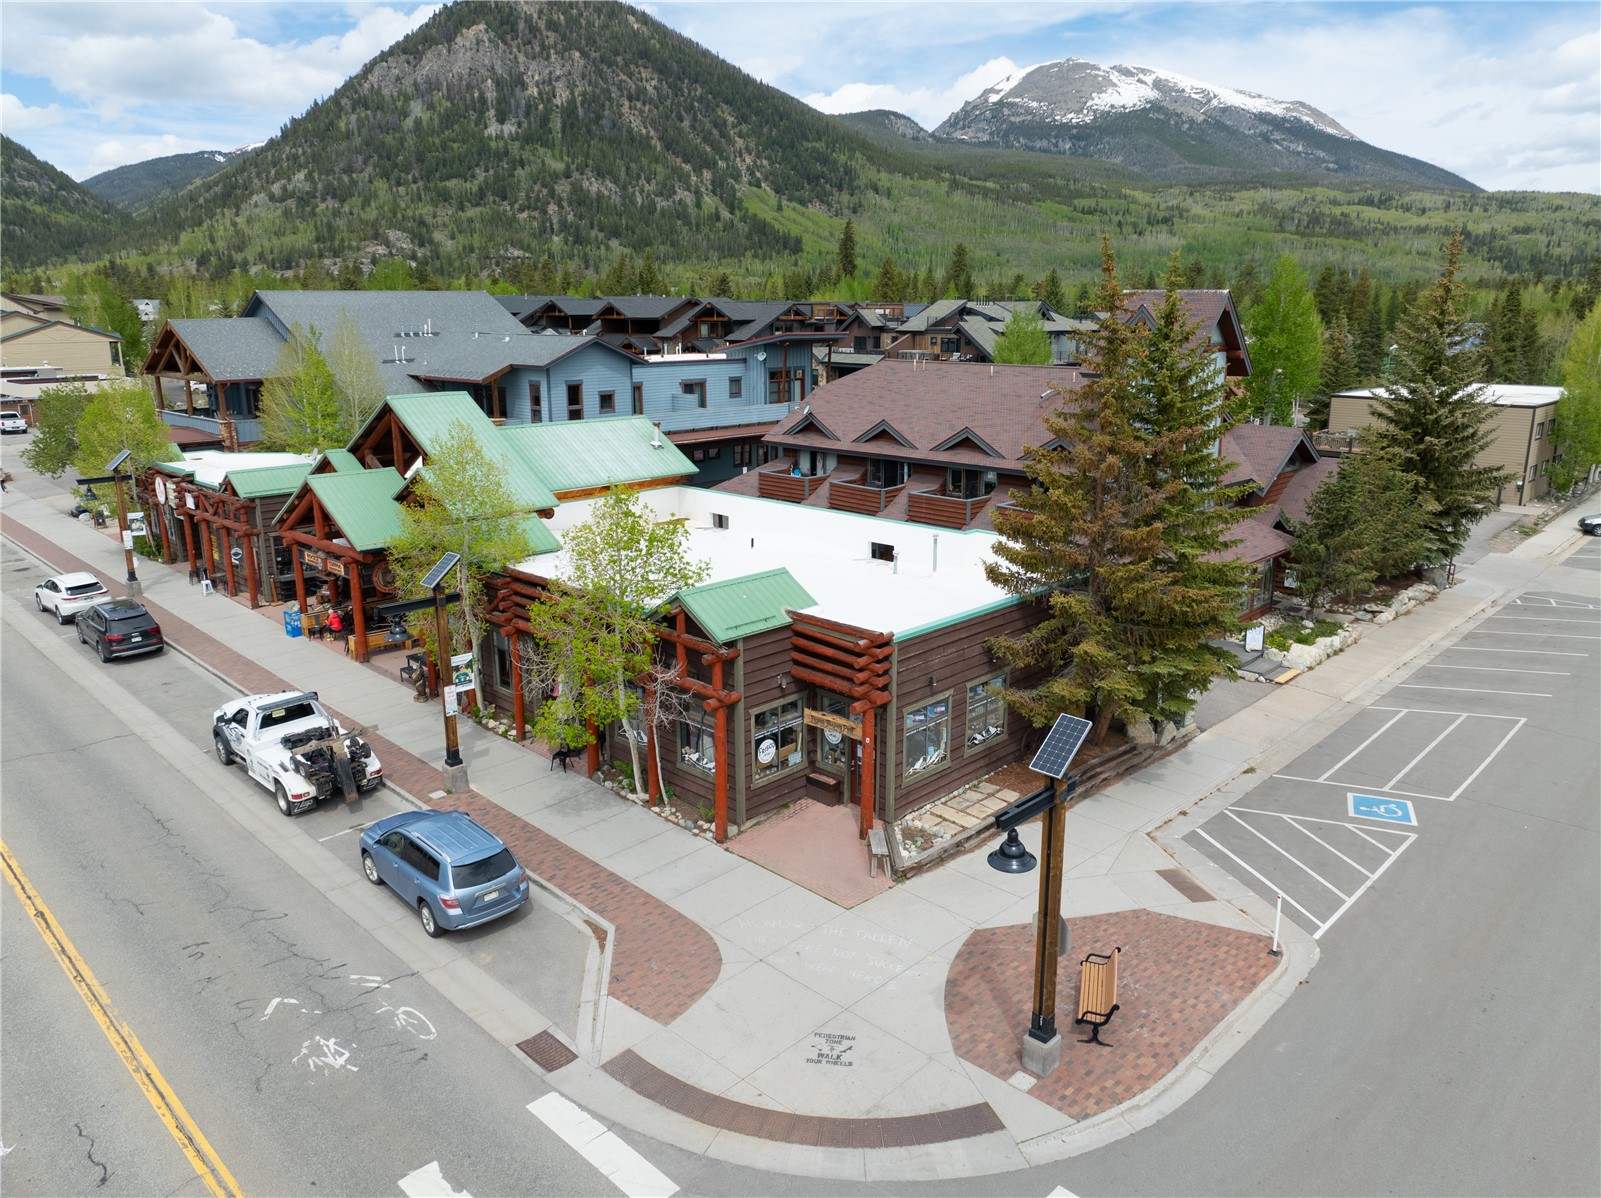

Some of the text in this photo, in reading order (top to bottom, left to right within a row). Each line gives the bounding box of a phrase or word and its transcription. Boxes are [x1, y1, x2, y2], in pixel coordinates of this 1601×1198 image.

[856, 929, 914, 948] FALLEN
[832, 947, 856, 960] NOT
[814, 1032, 856, 1041] PEDESTRIAN
[817, 1052, 843, 1061] WALK
